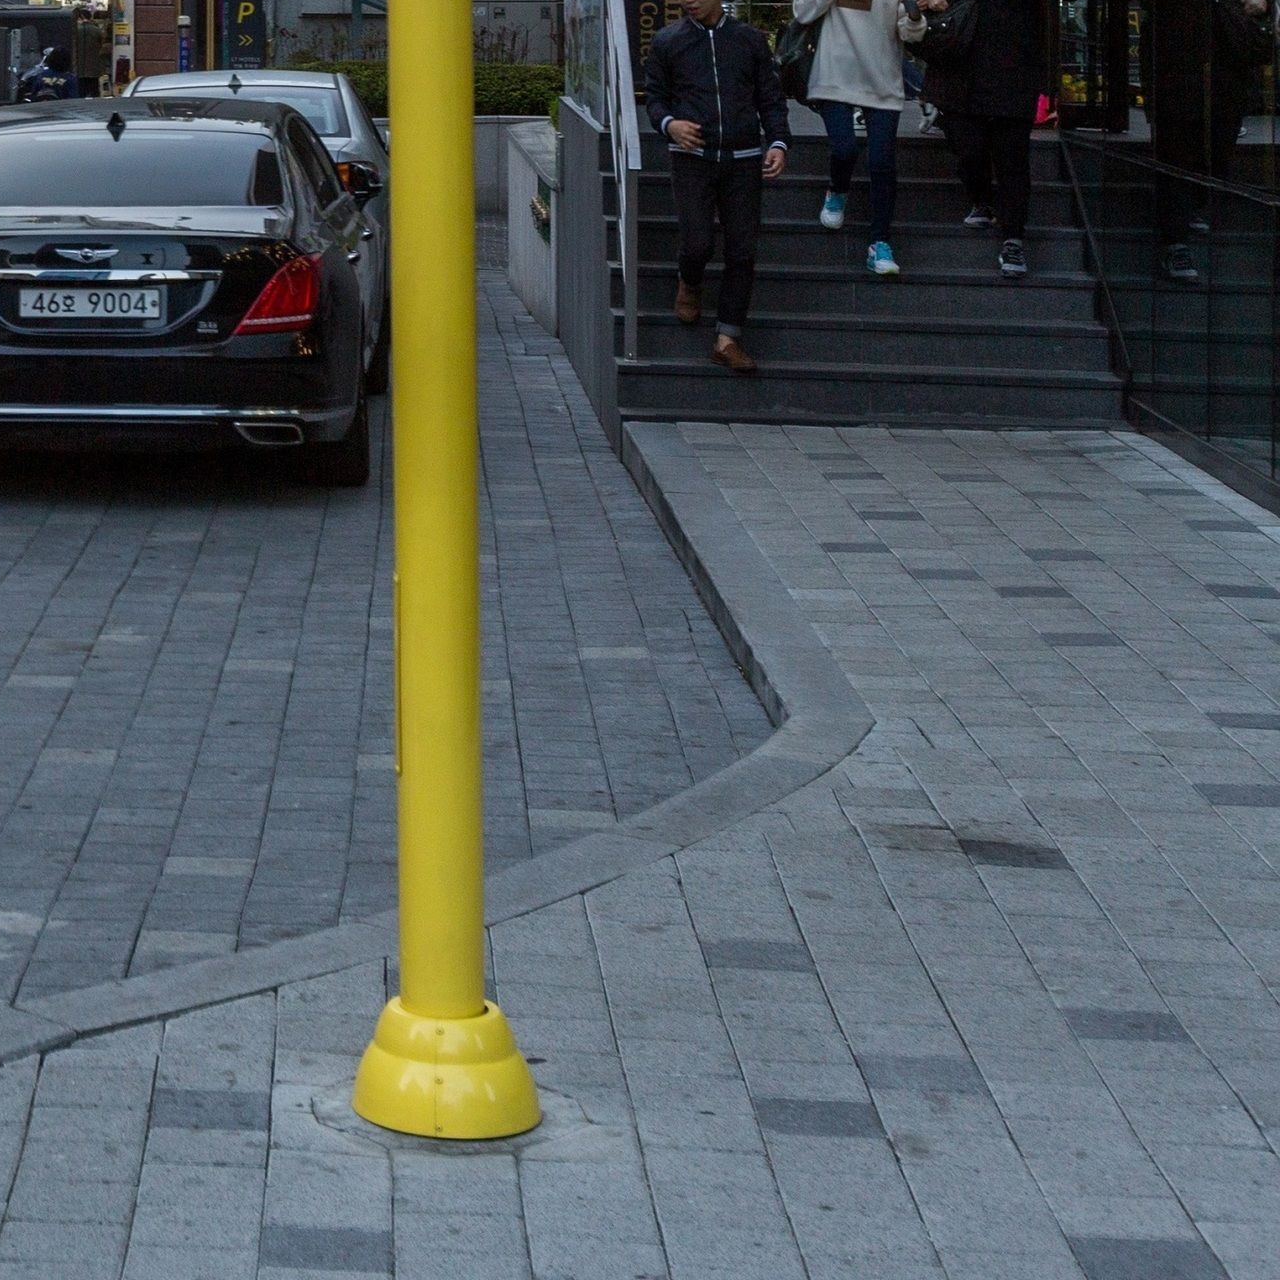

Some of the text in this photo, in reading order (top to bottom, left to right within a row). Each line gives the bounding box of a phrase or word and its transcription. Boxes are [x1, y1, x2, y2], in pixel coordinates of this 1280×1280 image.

[237, 2, 255, 24] P
[32, 292, 148, 314] 46호 9004
